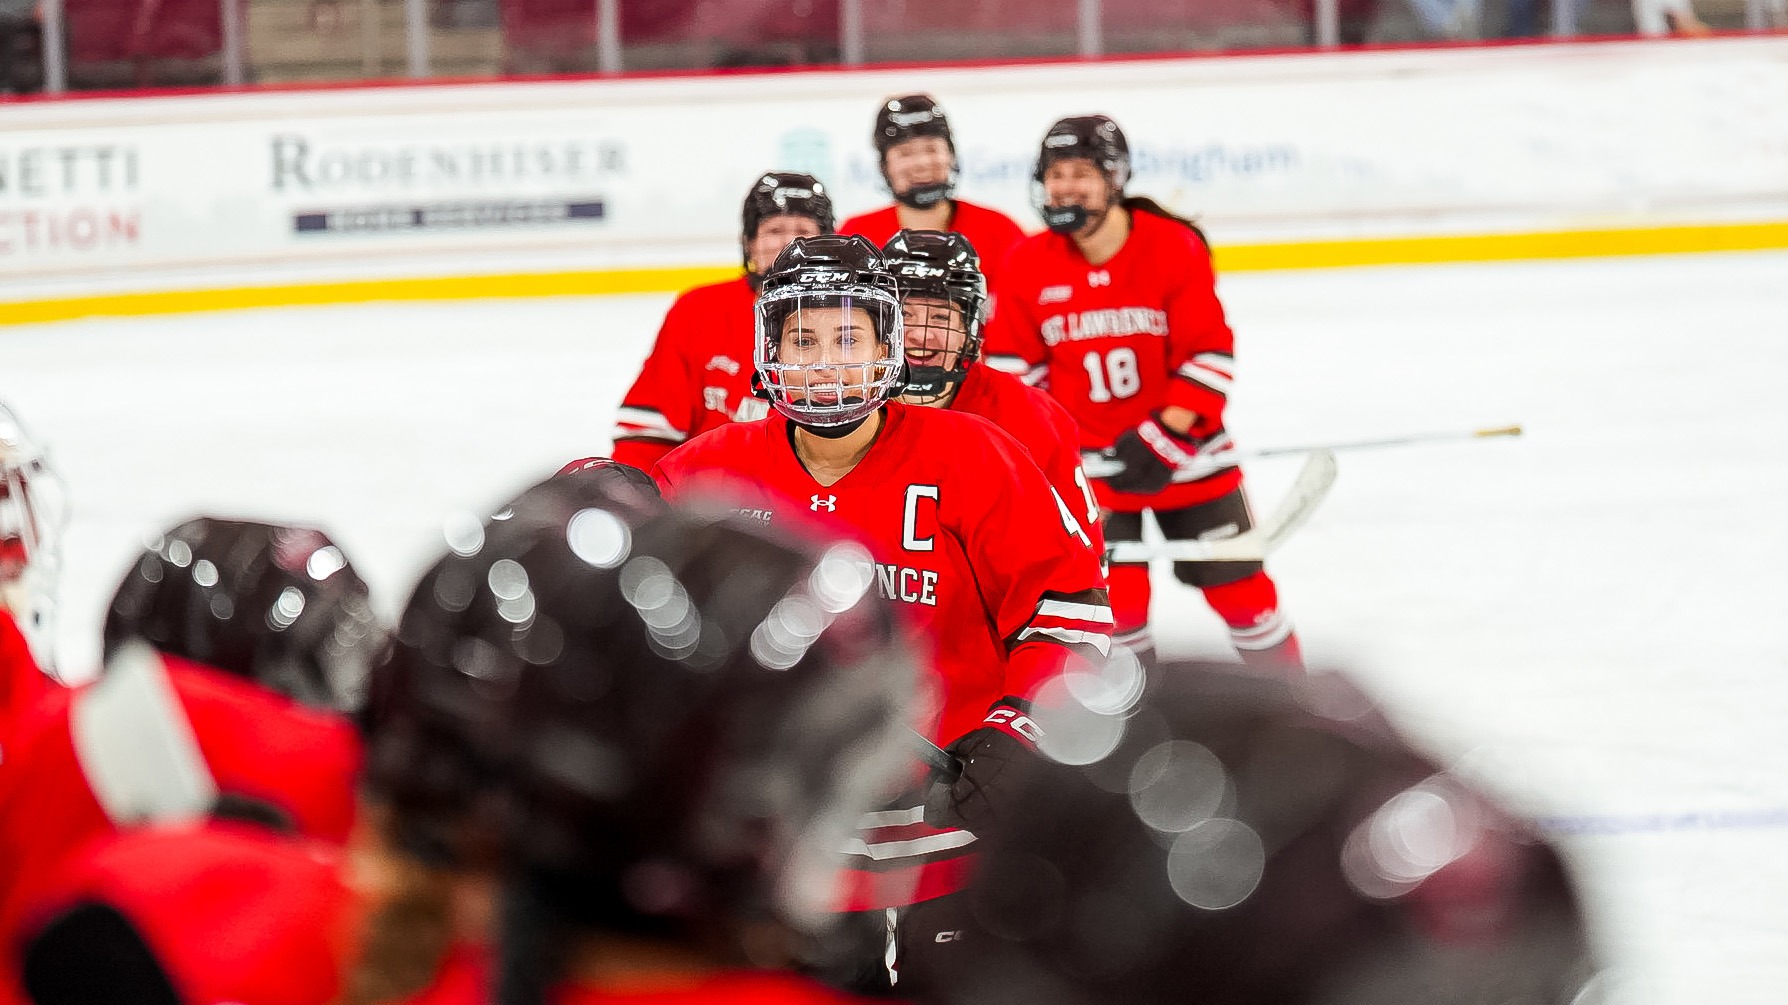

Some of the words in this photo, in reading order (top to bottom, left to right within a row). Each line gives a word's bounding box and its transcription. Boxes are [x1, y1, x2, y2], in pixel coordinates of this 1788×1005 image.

[800, 272, 849, 283] CCM
[1083, 347, 1140, 402] 18
[903, 485, 938, 551] C
[983, 709, 1046, 742] CC
